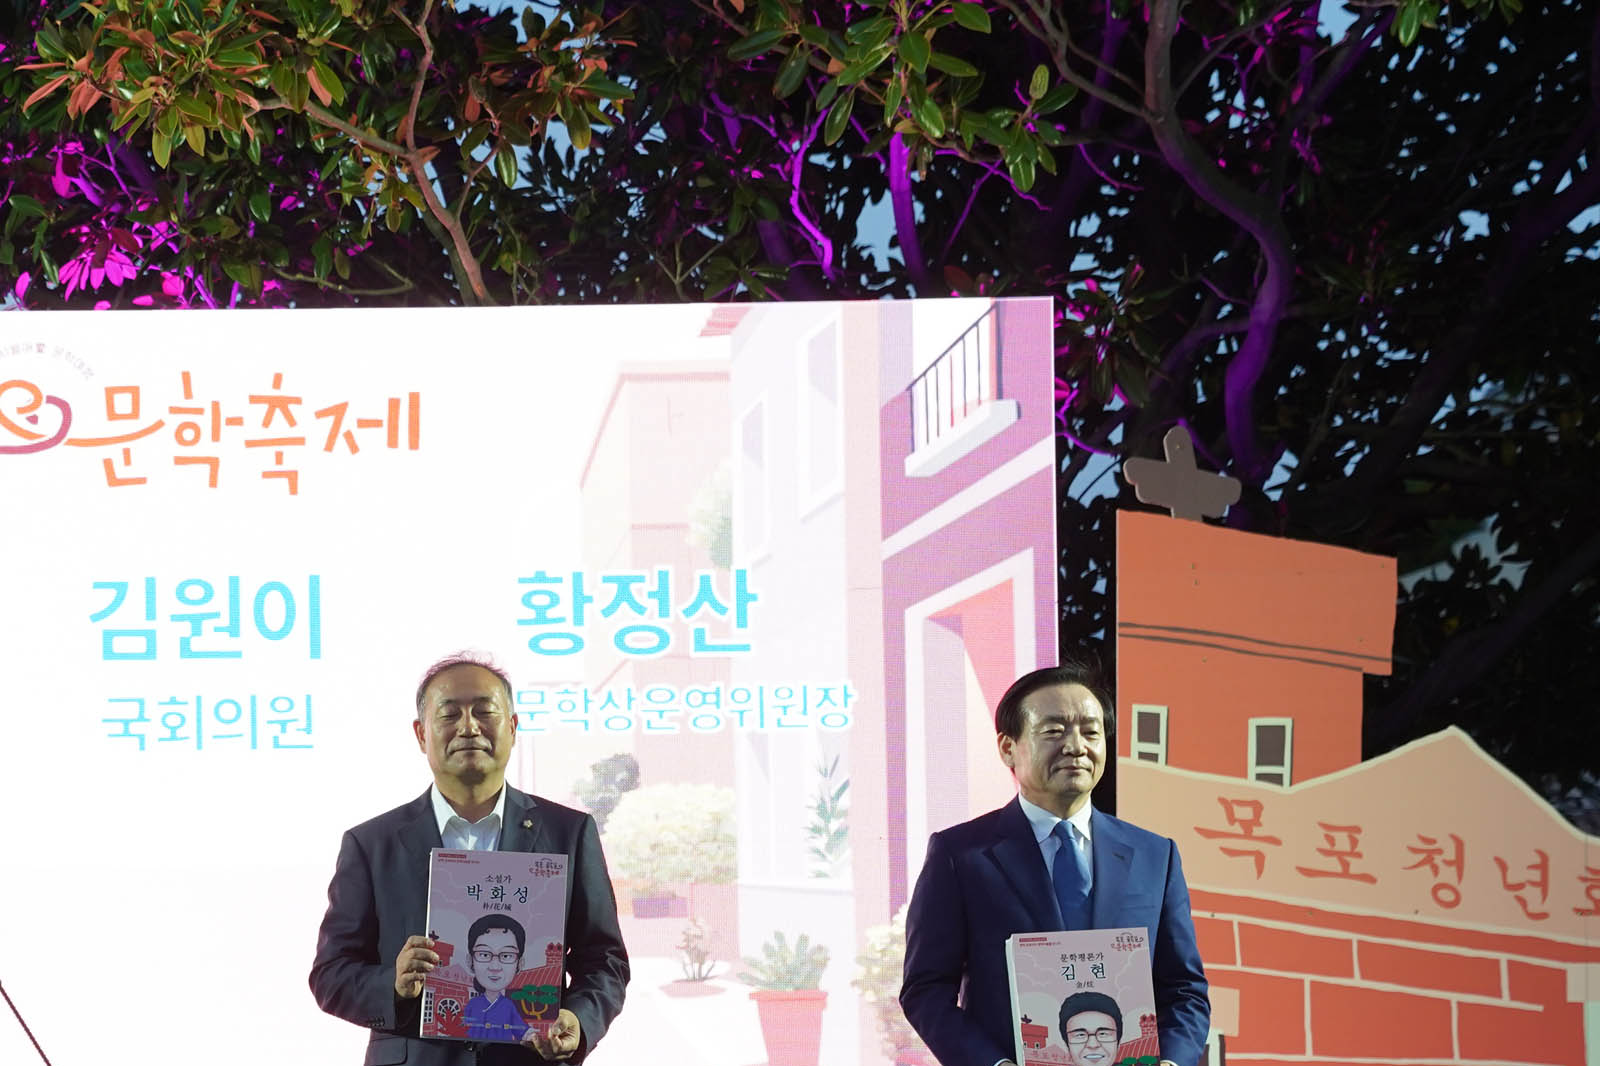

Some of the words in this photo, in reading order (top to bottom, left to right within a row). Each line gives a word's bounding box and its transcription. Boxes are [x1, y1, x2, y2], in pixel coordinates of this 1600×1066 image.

[65, 370, 420, 496] 문학축제
[88, 574, 323, 662] 김원이
[516, 568, 759, 657] 황정산
[100, 694, 315, 752] 국회의원
[466, 884, 529, 904] 박화성
[485, 874, 513, 885] 소설가
[1060, 952, 1104, 963] 문학평론가
